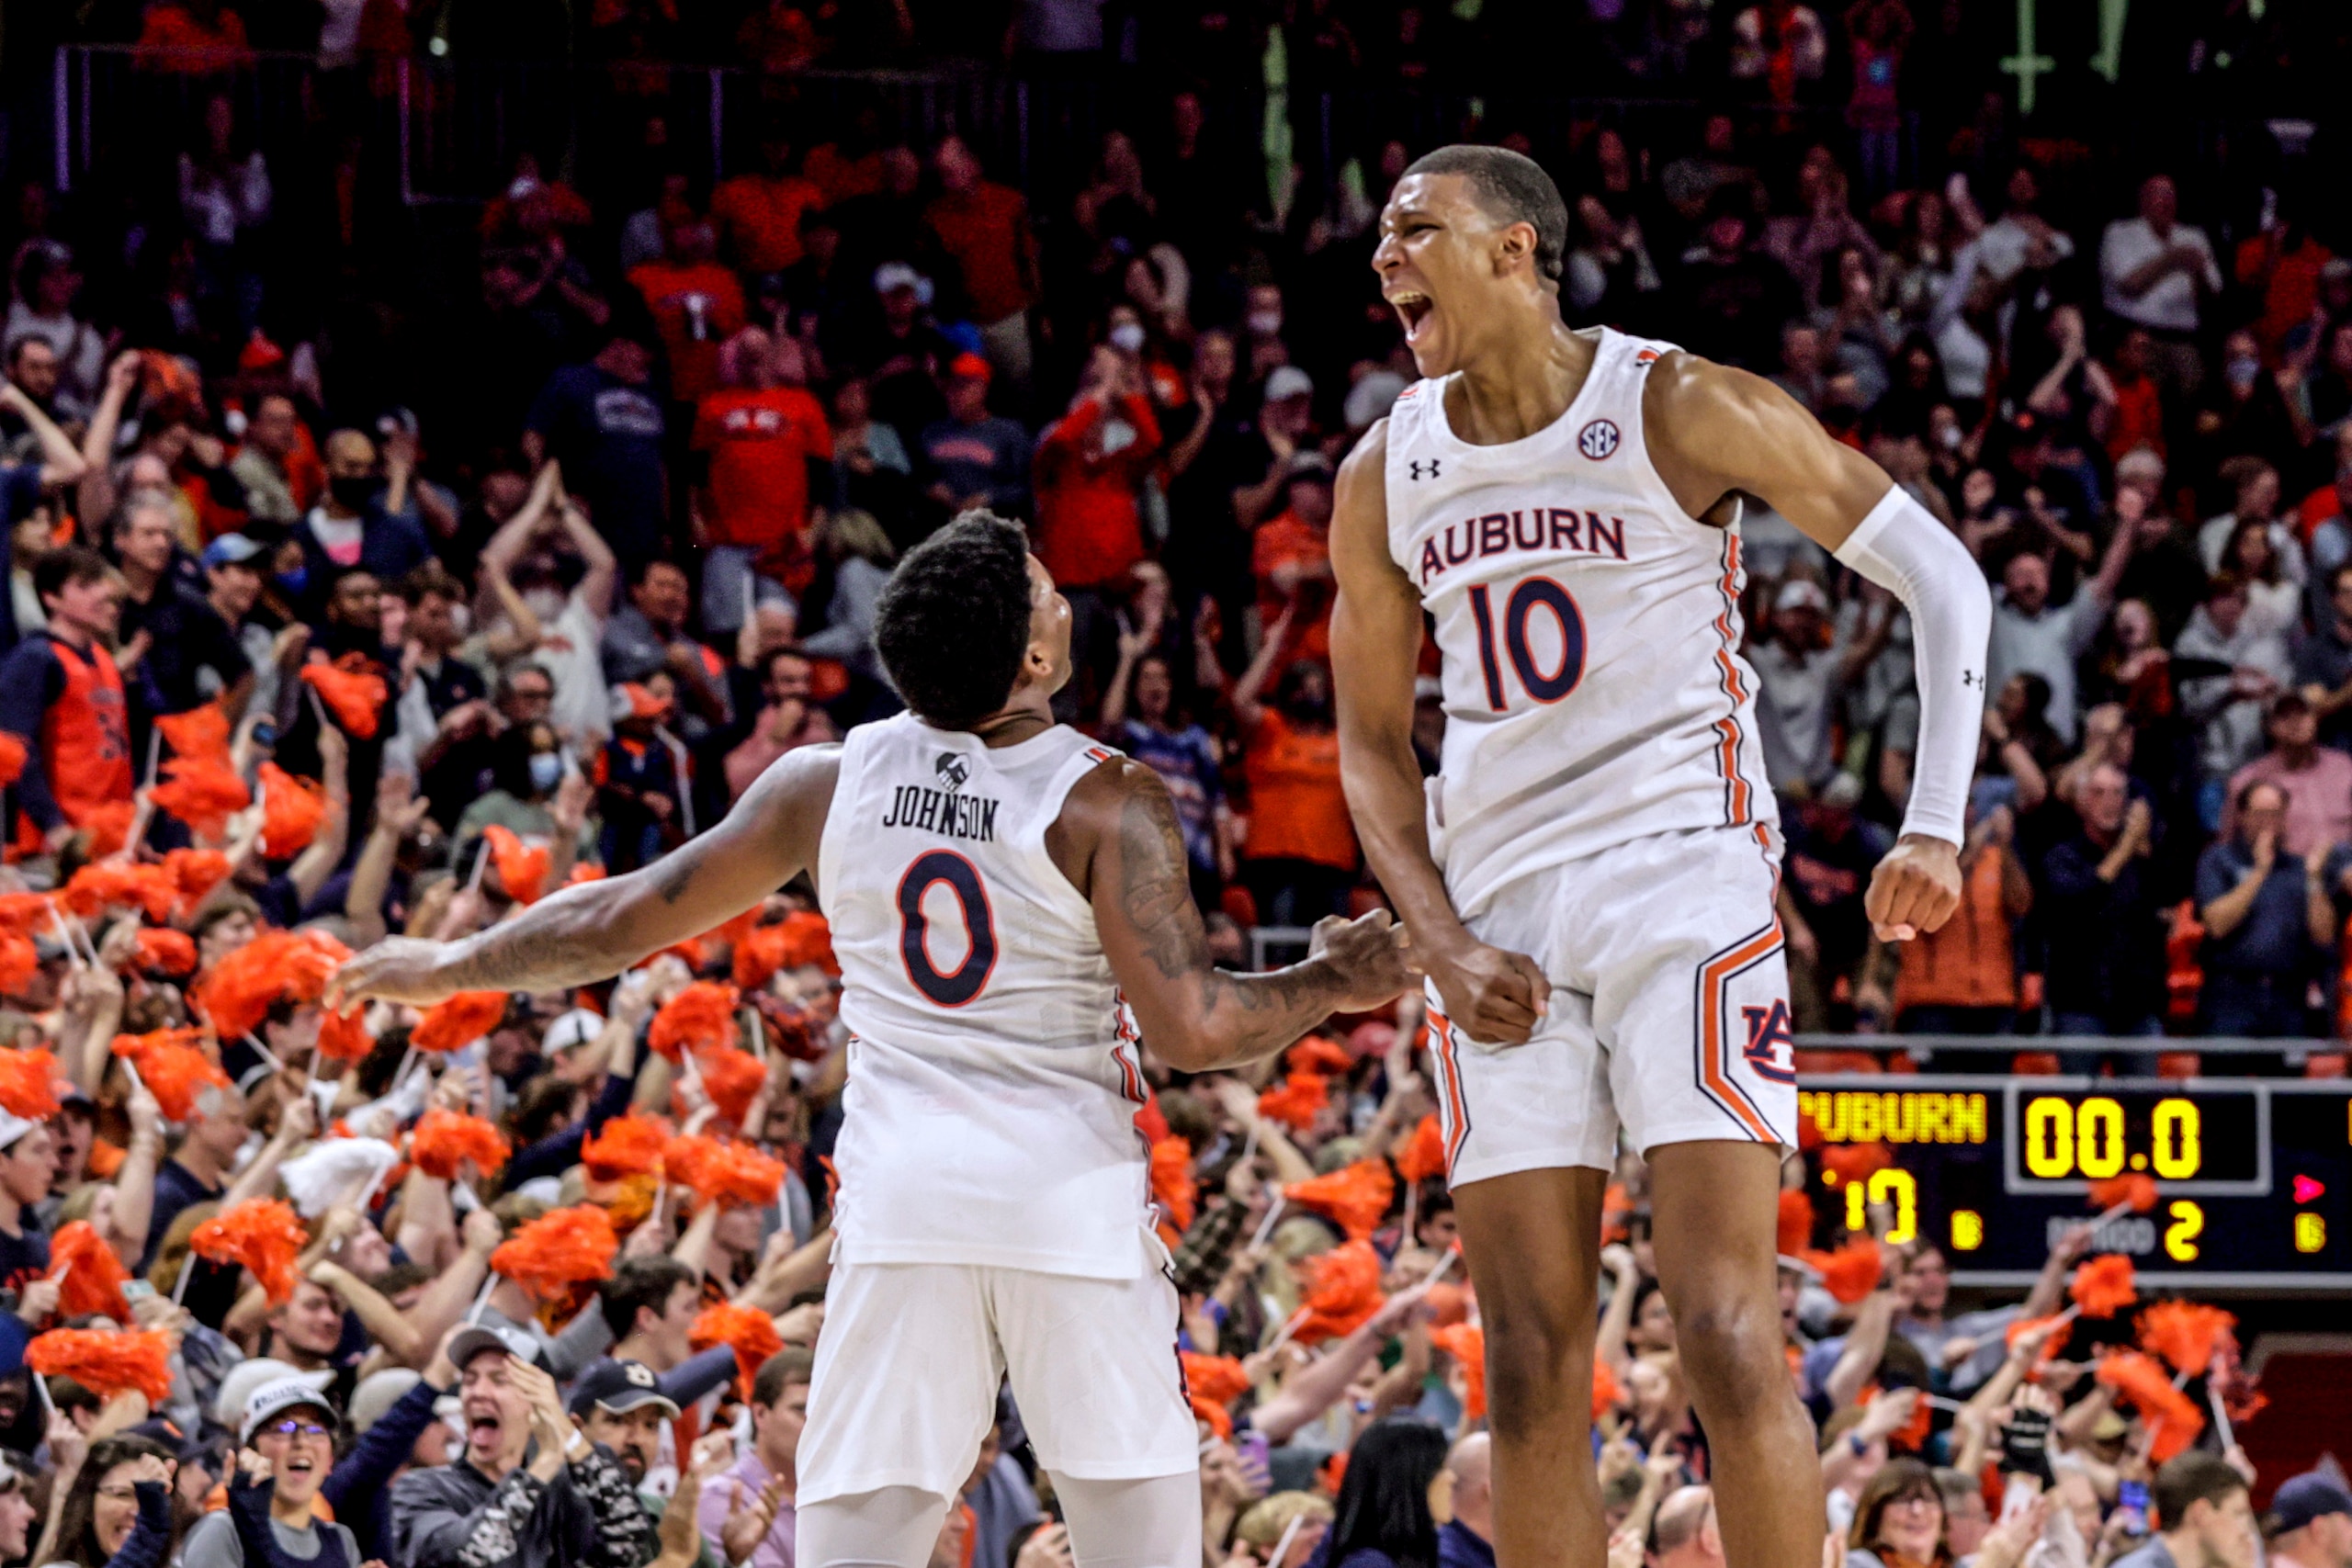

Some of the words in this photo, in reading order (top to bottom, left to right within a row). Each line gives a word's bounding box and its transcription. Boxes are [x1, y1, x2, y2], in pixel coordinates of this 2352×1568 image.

[1579, 419, 1620, 459] SEC
[1420, 508, 1629, 585] AUBURN
[1467, 575, 1588, 712] 10
[883, 785, 1001, 842] JOHNSON
[896, 848, 999, 1009] 0
[1798, 1092, 1987, 1144] UBURN
[2025, 1097, 2201, 1179] 00.0
[2164, 1200, 2204, 1262] 2
